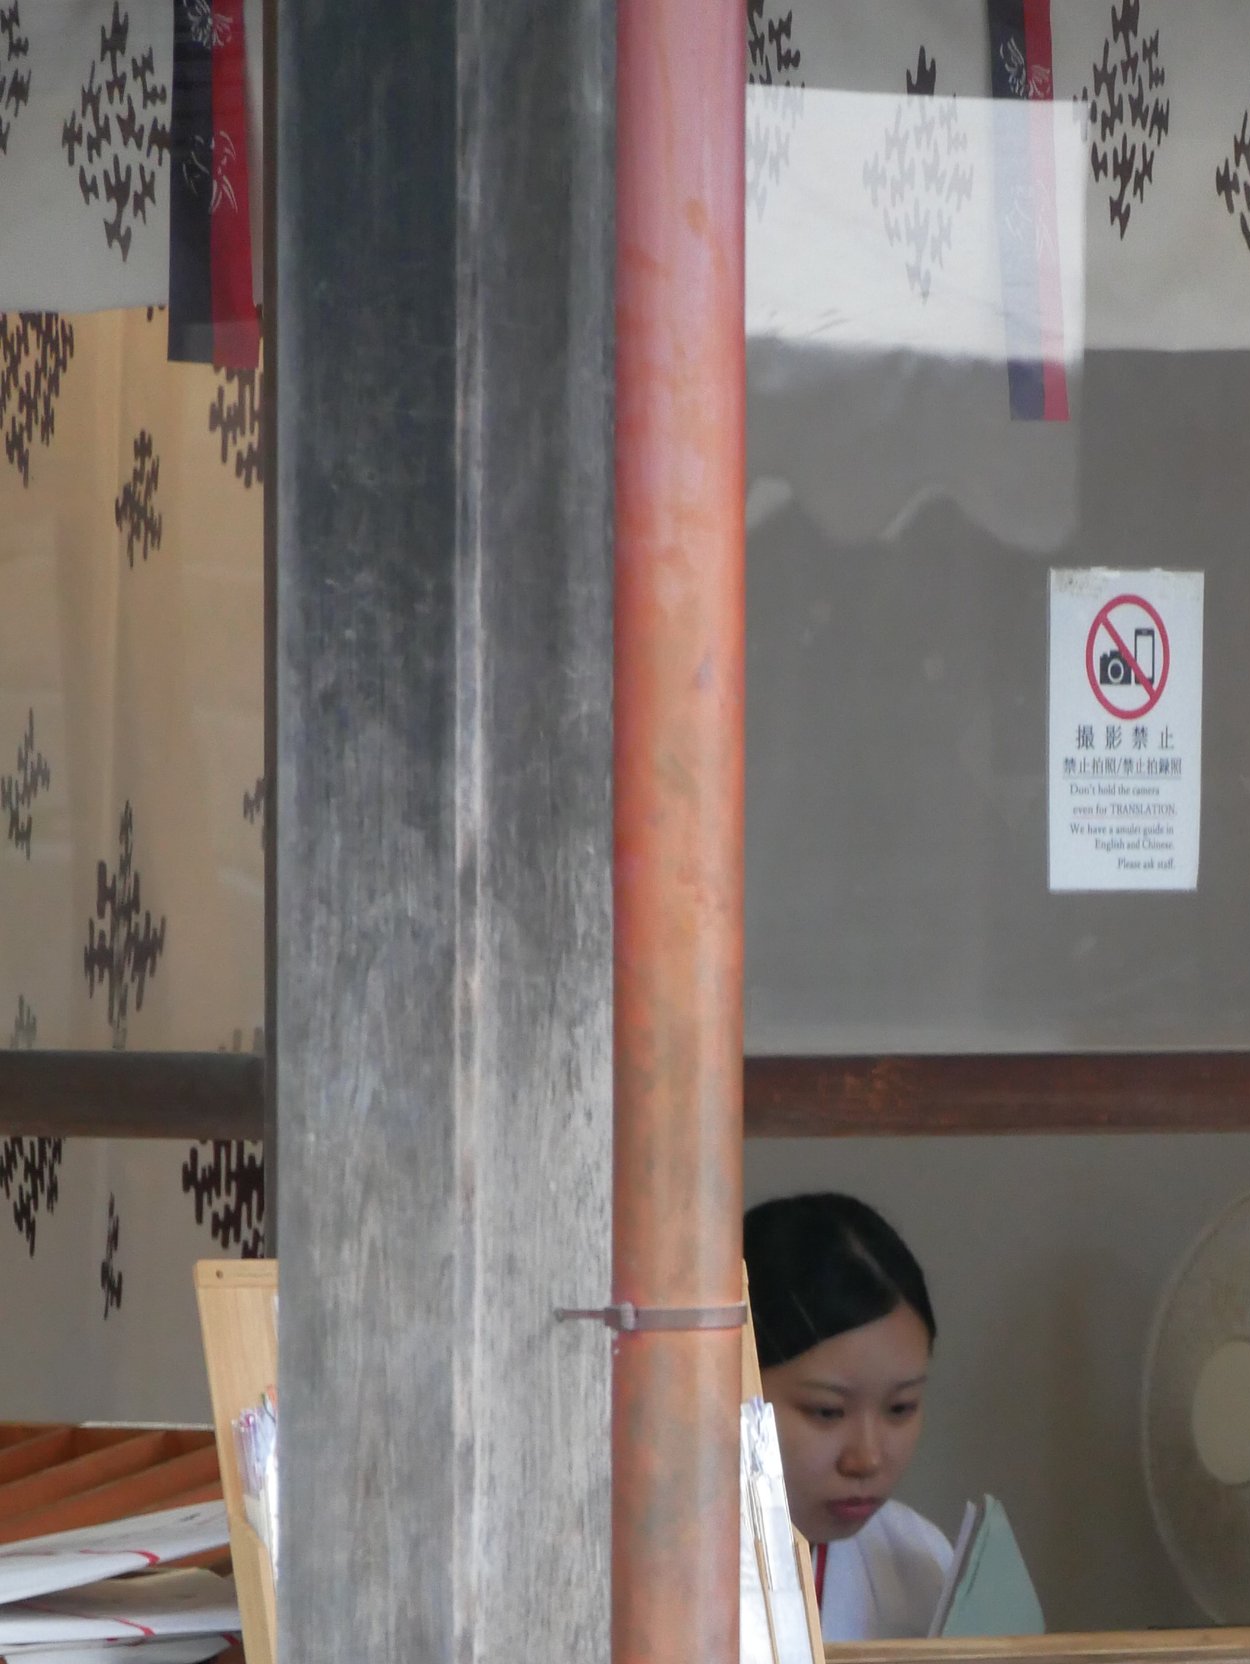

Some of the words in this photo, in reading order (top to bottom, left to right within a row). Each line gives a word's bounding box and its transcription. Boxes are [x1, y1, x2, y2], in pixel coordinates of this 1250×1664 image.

[1075, 724, 1175, 750] 撮影禁止
[1070, 783, 1096, 796] Don't
[1098, 783, 1116, 796] hold
[1118, 783, 1130, 796] the
[1132, 786, 1160, 796] camera
[1073, 805, 1094, 815] even
[1096, 803, 1107, 815] for
[1070, 823, 1085, 835] We
[1087, 823, 1106, 835] have
[1143, 823, 1164, 838] guide
[1166, 823, 1174, 835] in
[1095, 838, 1125, 852] English
[1126, 838, 1140, 850] and
[1118, 858, 1141, 870] Please
[1143, 858, 1154, 870] ask
